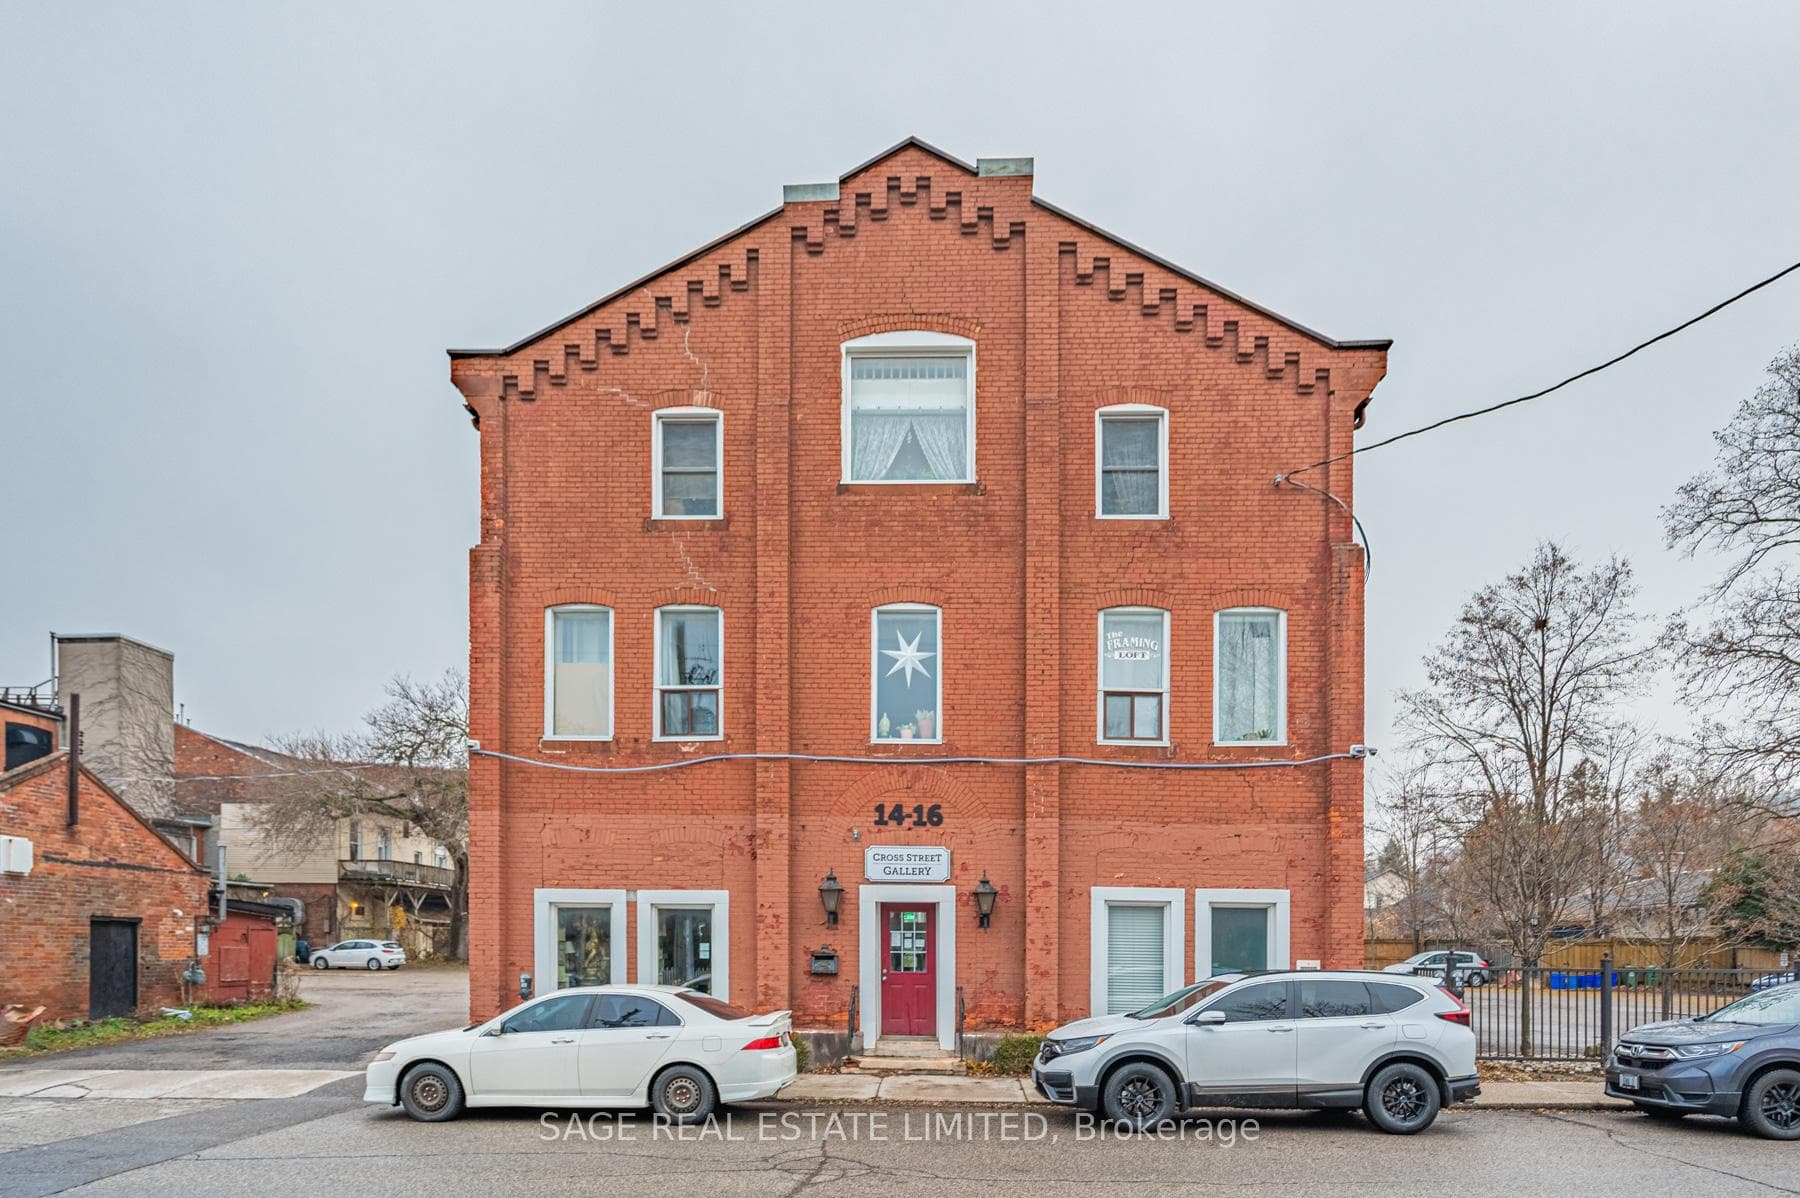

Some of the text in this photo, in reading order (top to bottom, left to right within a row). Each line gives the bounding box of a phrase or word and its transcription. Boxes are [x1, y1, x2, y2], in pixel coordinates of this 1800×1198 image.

[1106, 637, 1159, 651] FRAMING
[873, 803, 944, 827] 14-16
[872, 853, 942, 863] CROSS STREET
[883, 866, 932, 876] GALLERY
